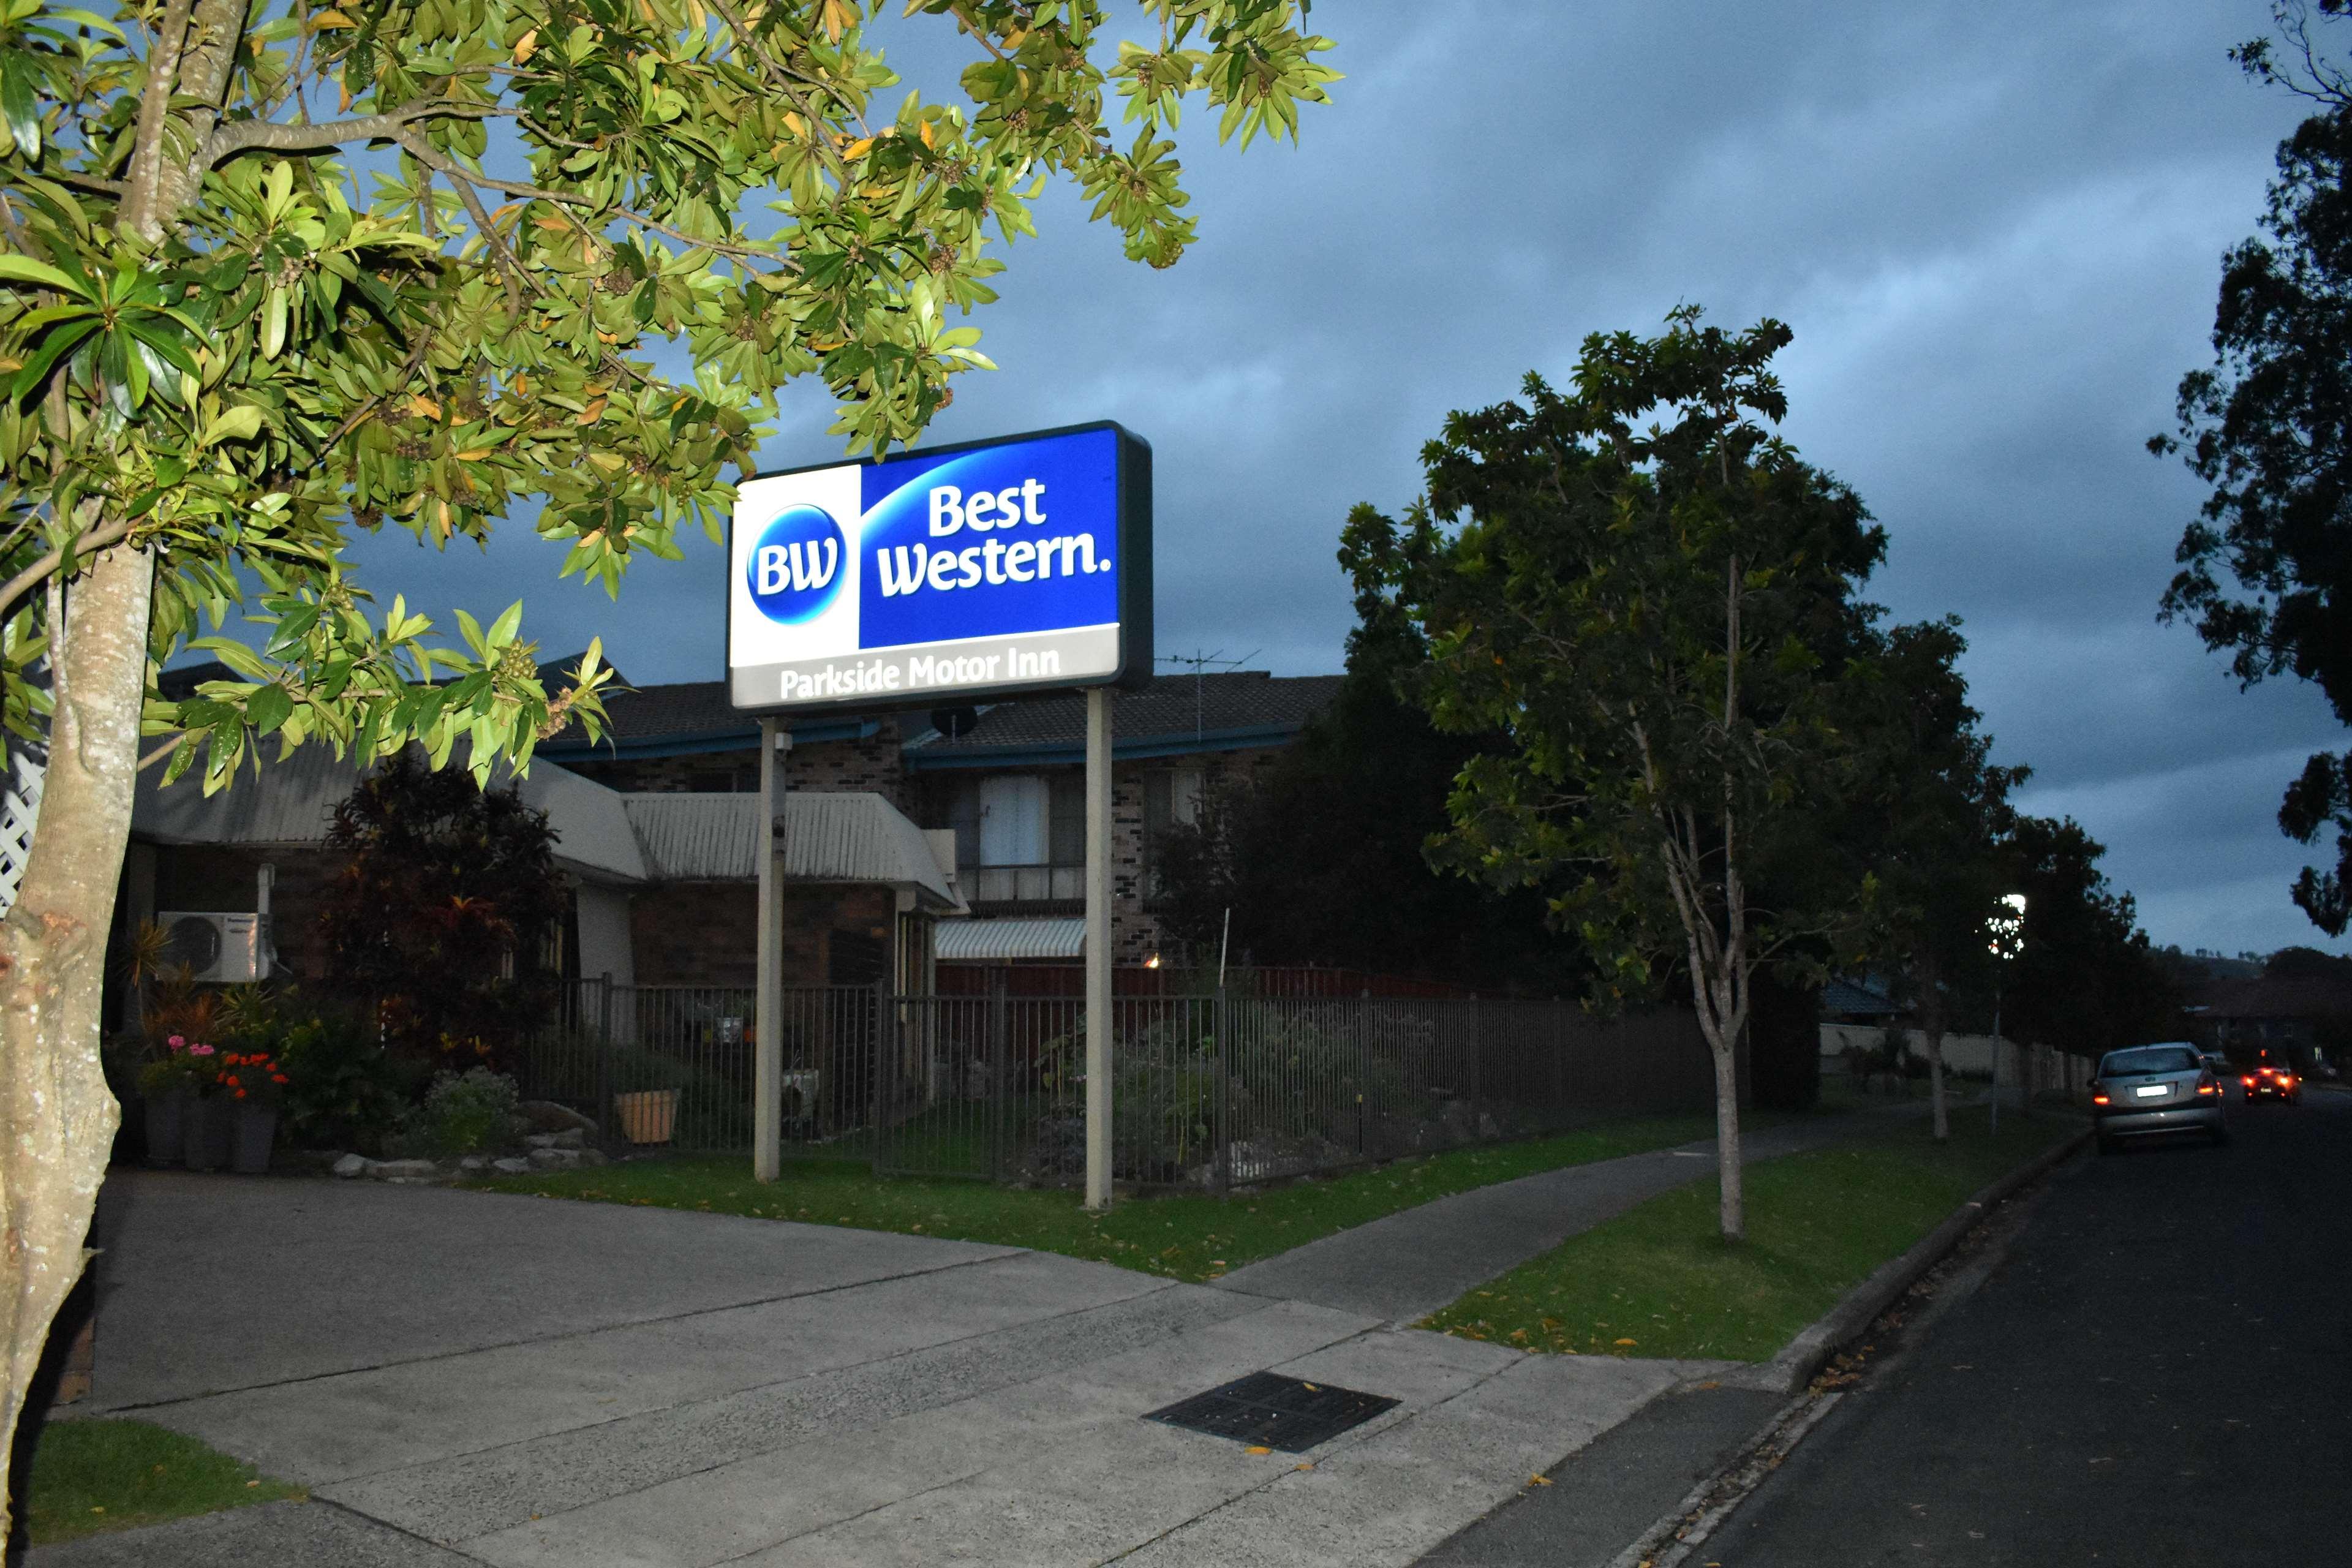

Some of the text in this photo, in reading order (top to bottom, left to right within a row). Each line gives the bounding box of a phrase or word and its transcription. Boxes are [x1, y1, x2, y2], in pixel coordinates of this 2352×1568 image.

[929, 478, 1047, 537] Best
[758, 537, 838, 595] BW
[781, 647, 1061, 699] Parkside Motor Inn
